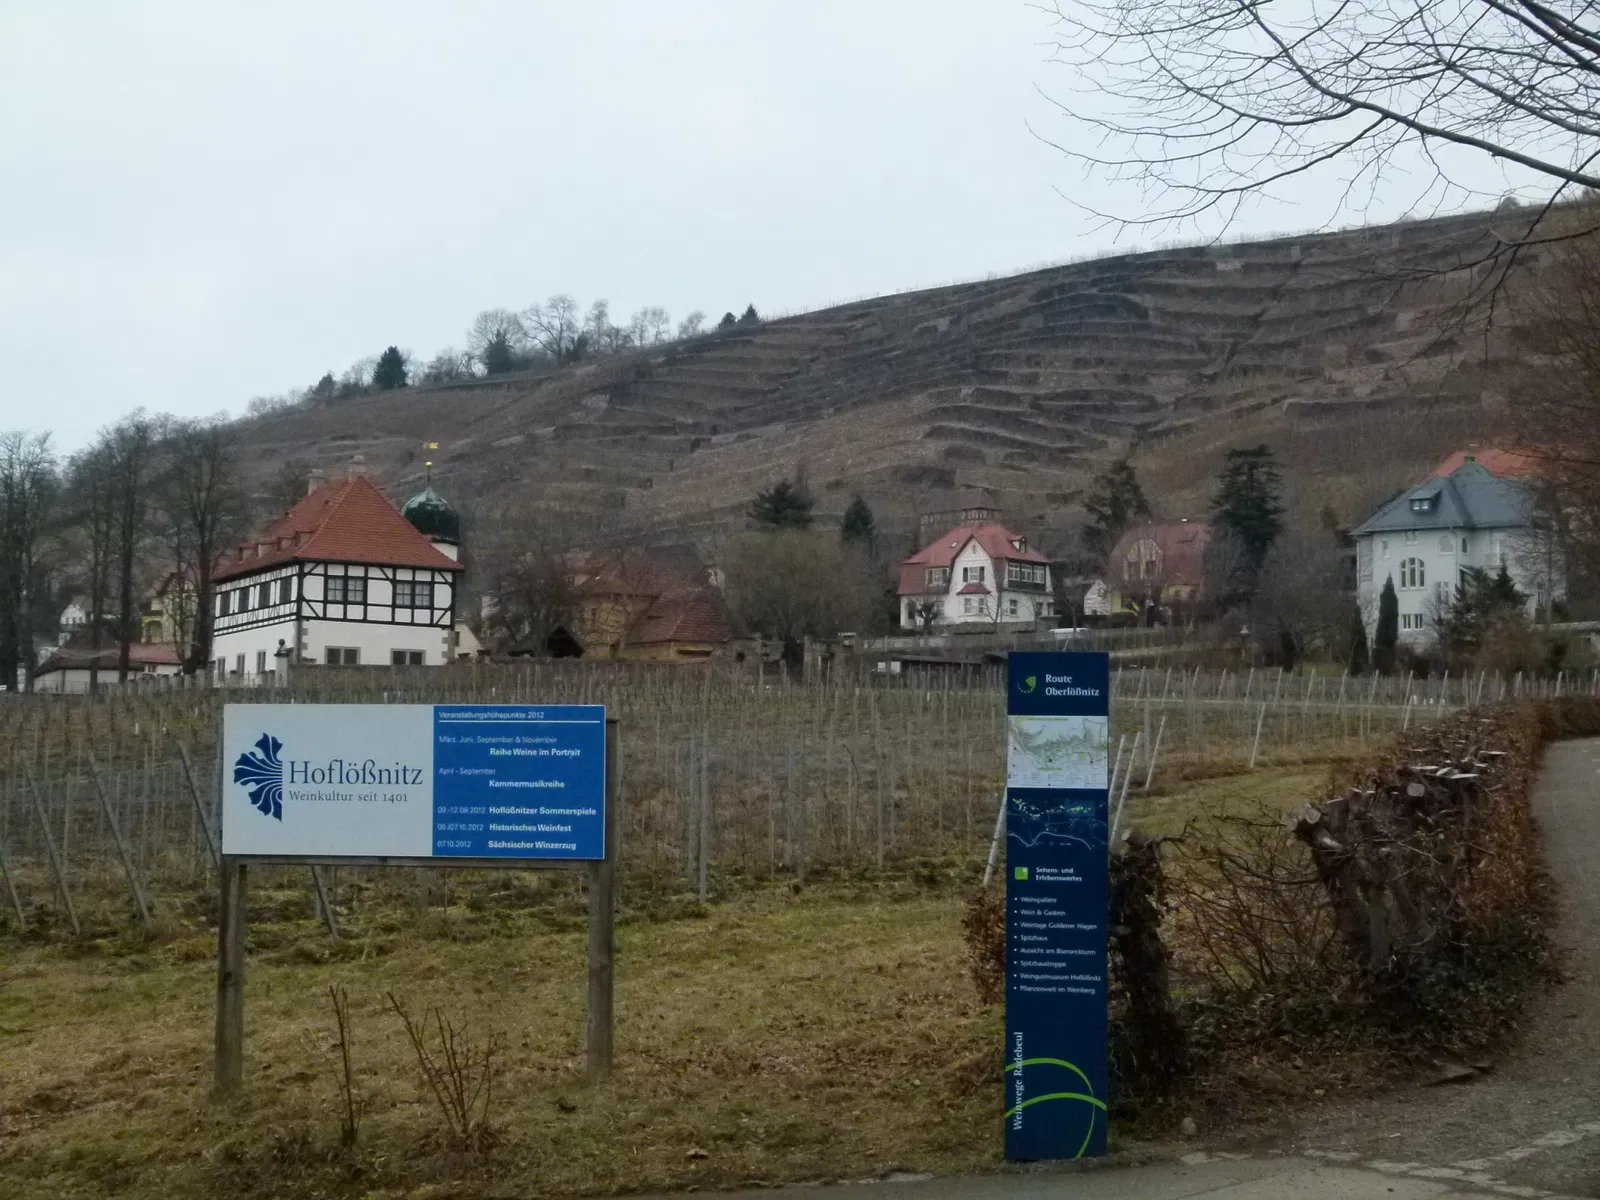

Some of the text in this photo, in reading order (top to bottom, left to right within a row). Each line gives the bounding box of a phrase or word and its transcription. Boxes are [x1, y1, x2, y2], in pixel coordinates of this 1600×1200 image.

[1045, 673, 1072, 683] Route
[1045, 687, 1100, 696] Oberlößnitz
[438, 711, 545, 719] Veranstaltungshöhepunkte 2012
[476, 736, 513, 744] September
[489, 747, 512, 756] Reihe
[513, 748, 537, 756] Weine
[551, 749, 581, 757] Portrait
[289, 759, 424, 785] Hoflößnitz
[438, 767, 454, 775] April
[459, 768, 496, 776] September
[489, 779, 566, 789] Kammermusikreihe
[288, 791, 408, 803] Weinkultur seit 1401
[489, 806, 538, 815] Hoflößnitzer
[539, 807, 596, 816] Sommerspiele
[489, 824, 537, 832] Historisches
[537, 824, 572, 832] Weinfest
[488, 840, 535, 849] Sächsischer
[535, 841, 577, 850] Winzerzug
[1021, 960, 1067, 968] Spitzhaustreppe
[1013, 1032, 1024, 1130] Weinwege Radebeul
